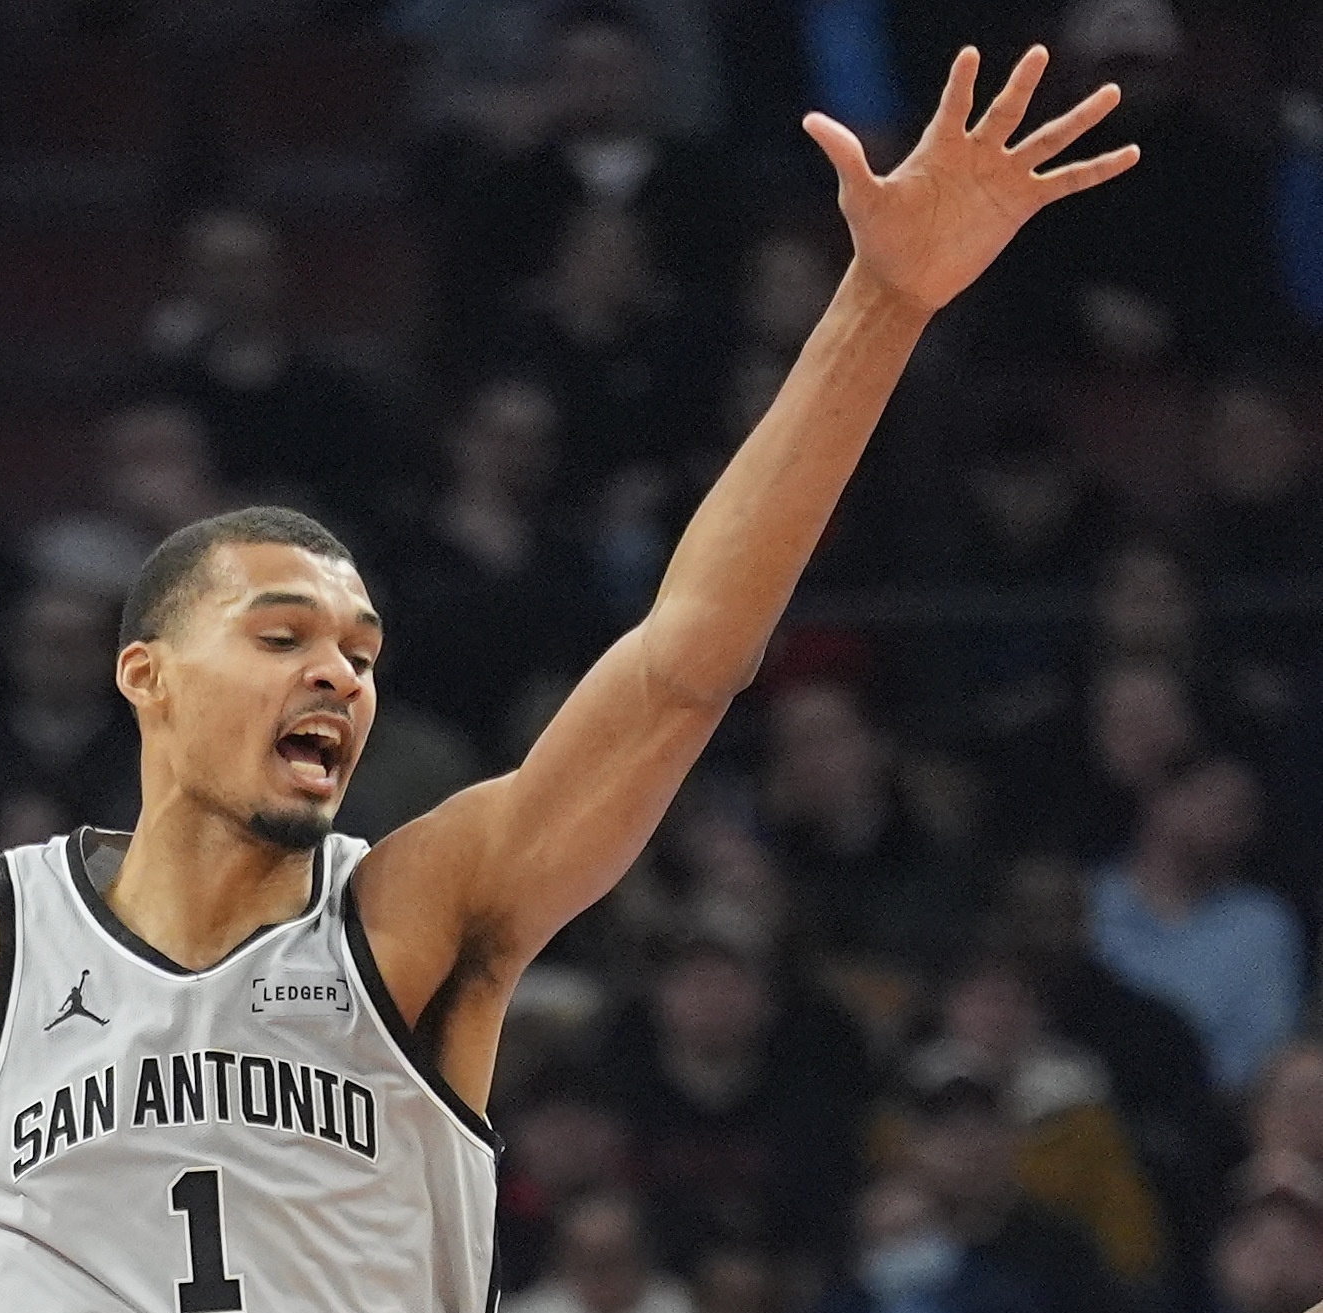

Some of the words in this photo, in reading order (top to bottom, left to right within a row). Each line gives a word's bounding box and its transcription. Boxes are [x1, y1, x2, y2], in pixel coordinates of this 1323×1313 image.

[263, 985, 337, 1002] LEDGER
[10, 1061, 118, 1183] SAN
[130, 1050, 378, 1164] ANTONIO
